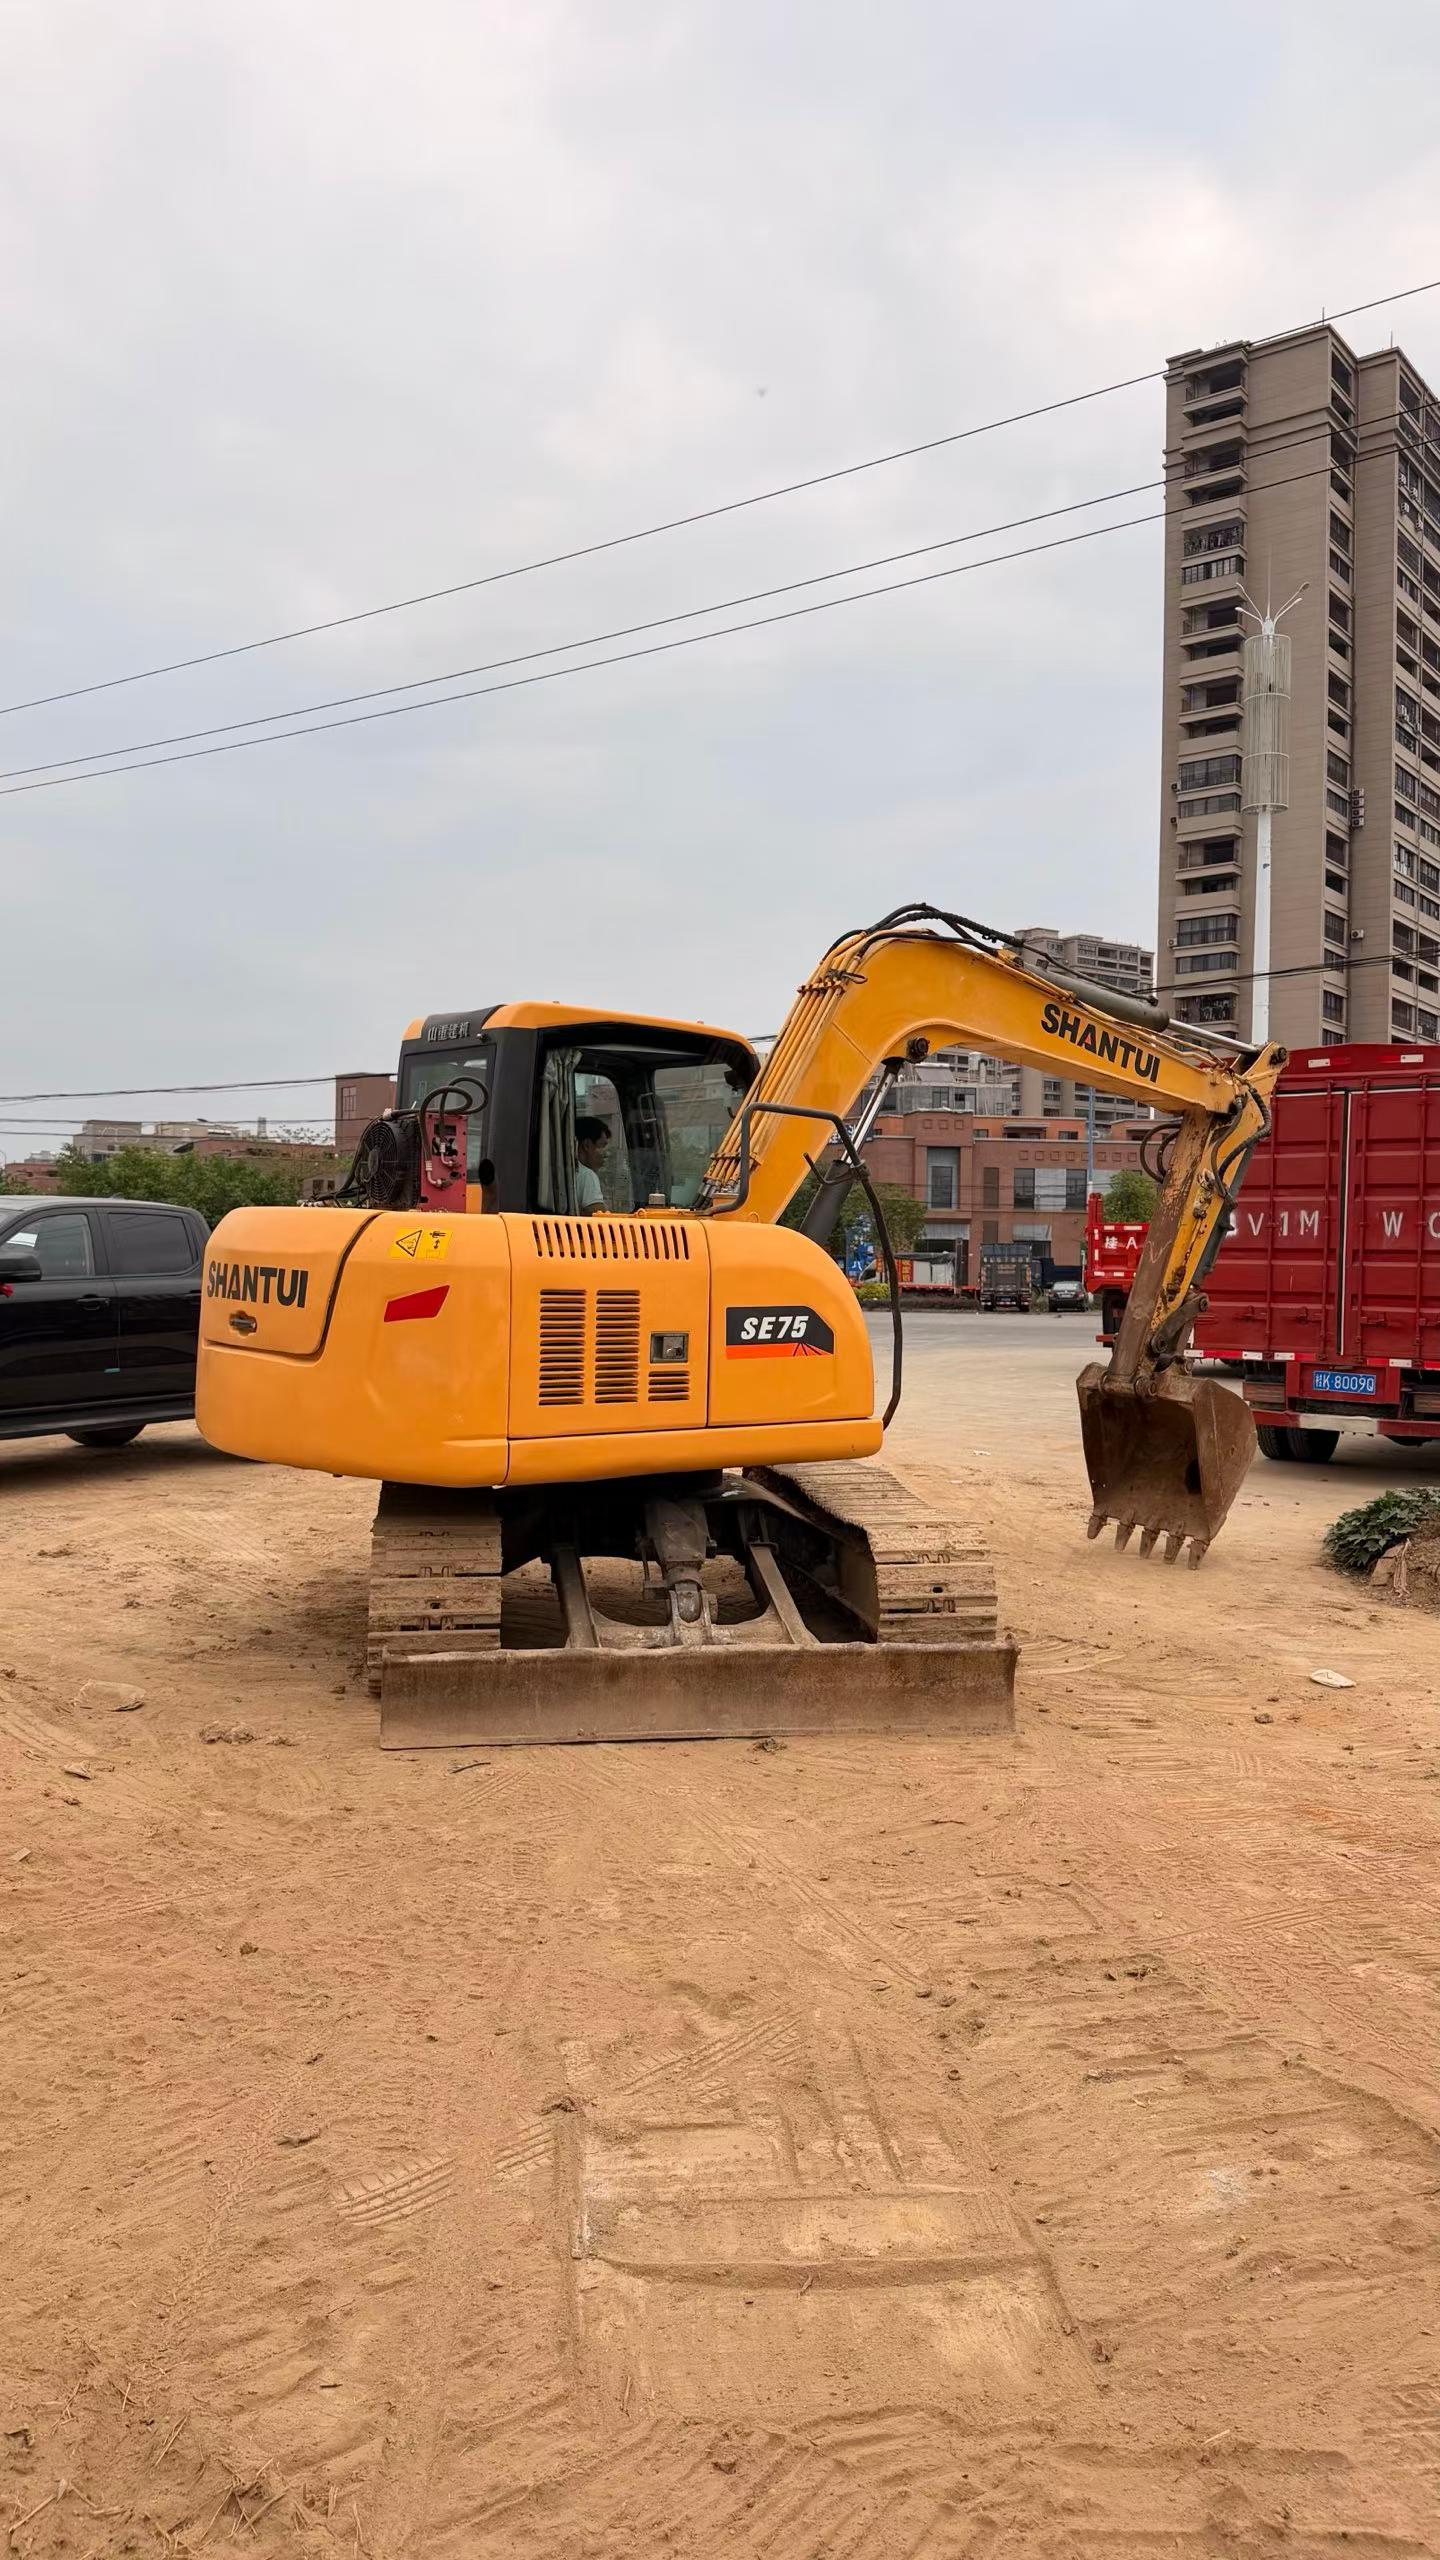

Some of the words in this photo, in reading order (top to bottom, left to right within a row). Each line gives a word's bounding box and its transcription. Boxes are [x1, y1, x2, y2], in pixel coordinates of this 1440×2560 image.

[1040, 1003, 1161, 1083] SHANTUI
[207, 1260, 309, 1308] SHANTUI
[740, 1315, 809, 1340] SE75
